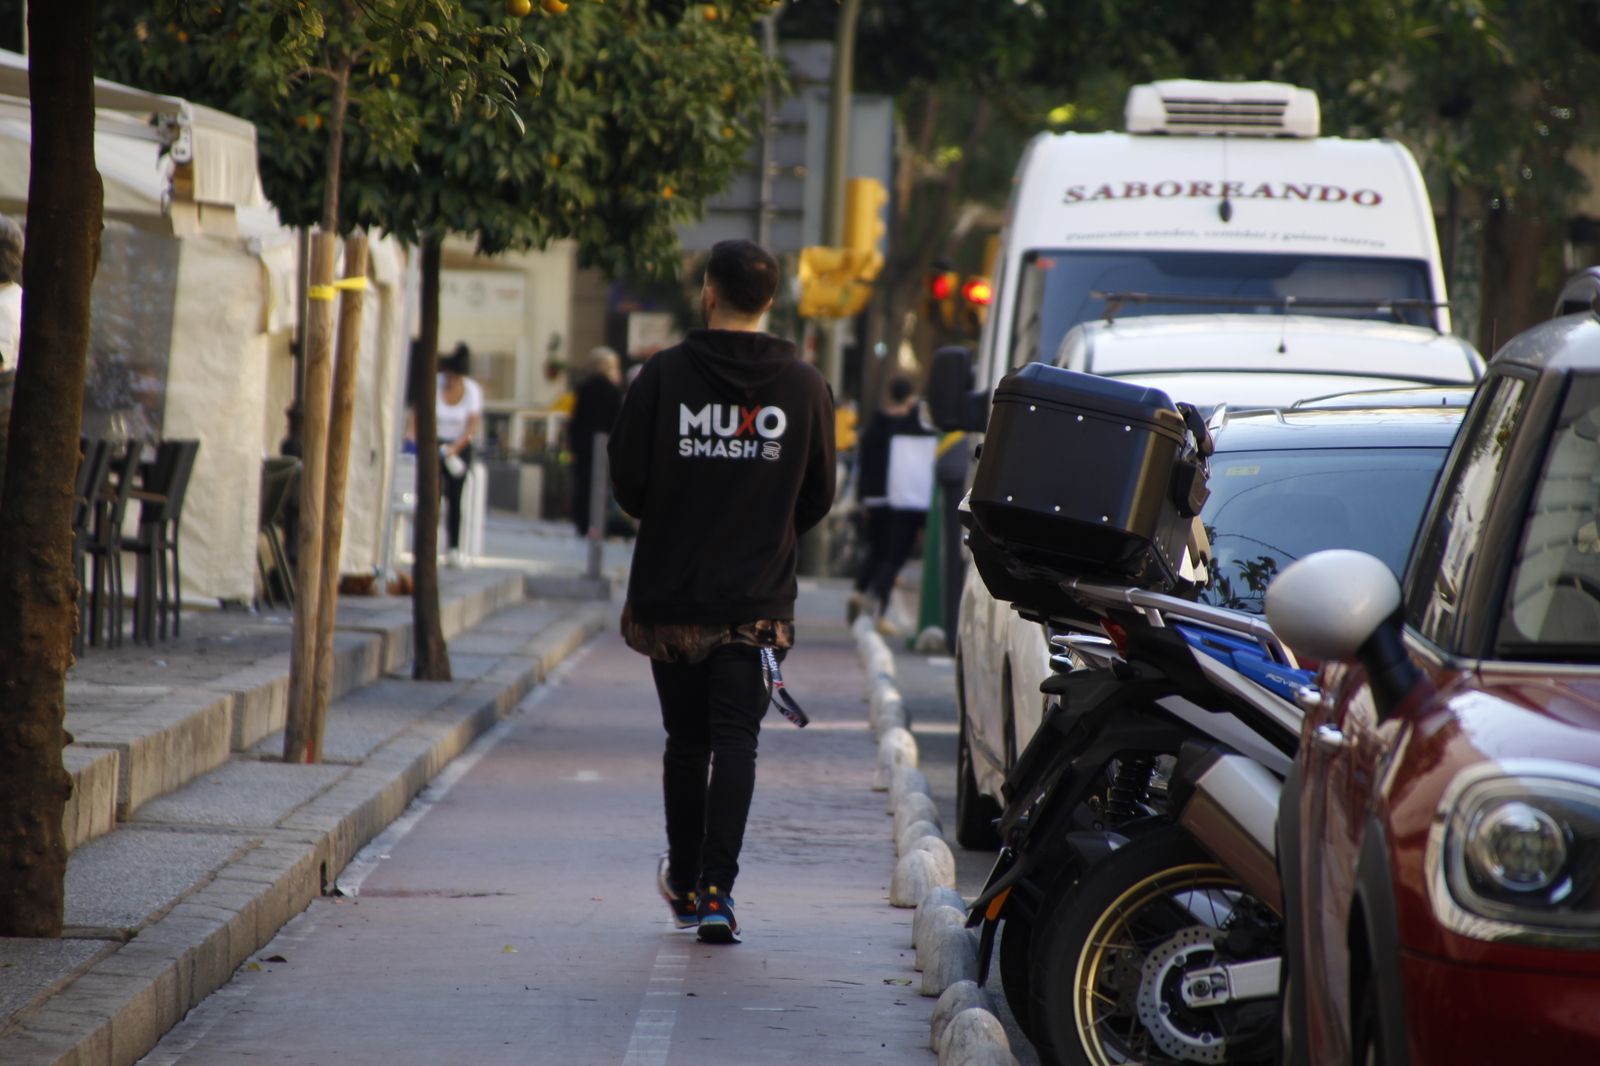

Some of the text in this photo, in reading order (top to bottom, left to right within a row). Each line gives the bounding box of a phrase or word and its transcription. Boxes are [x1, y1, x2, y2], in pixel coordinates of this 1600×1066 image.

[1063, 181, 1382, 206] SABOREANDO
[679, 403, 786, 438] MUXO
[679, 438, 758, 458] SMASH
